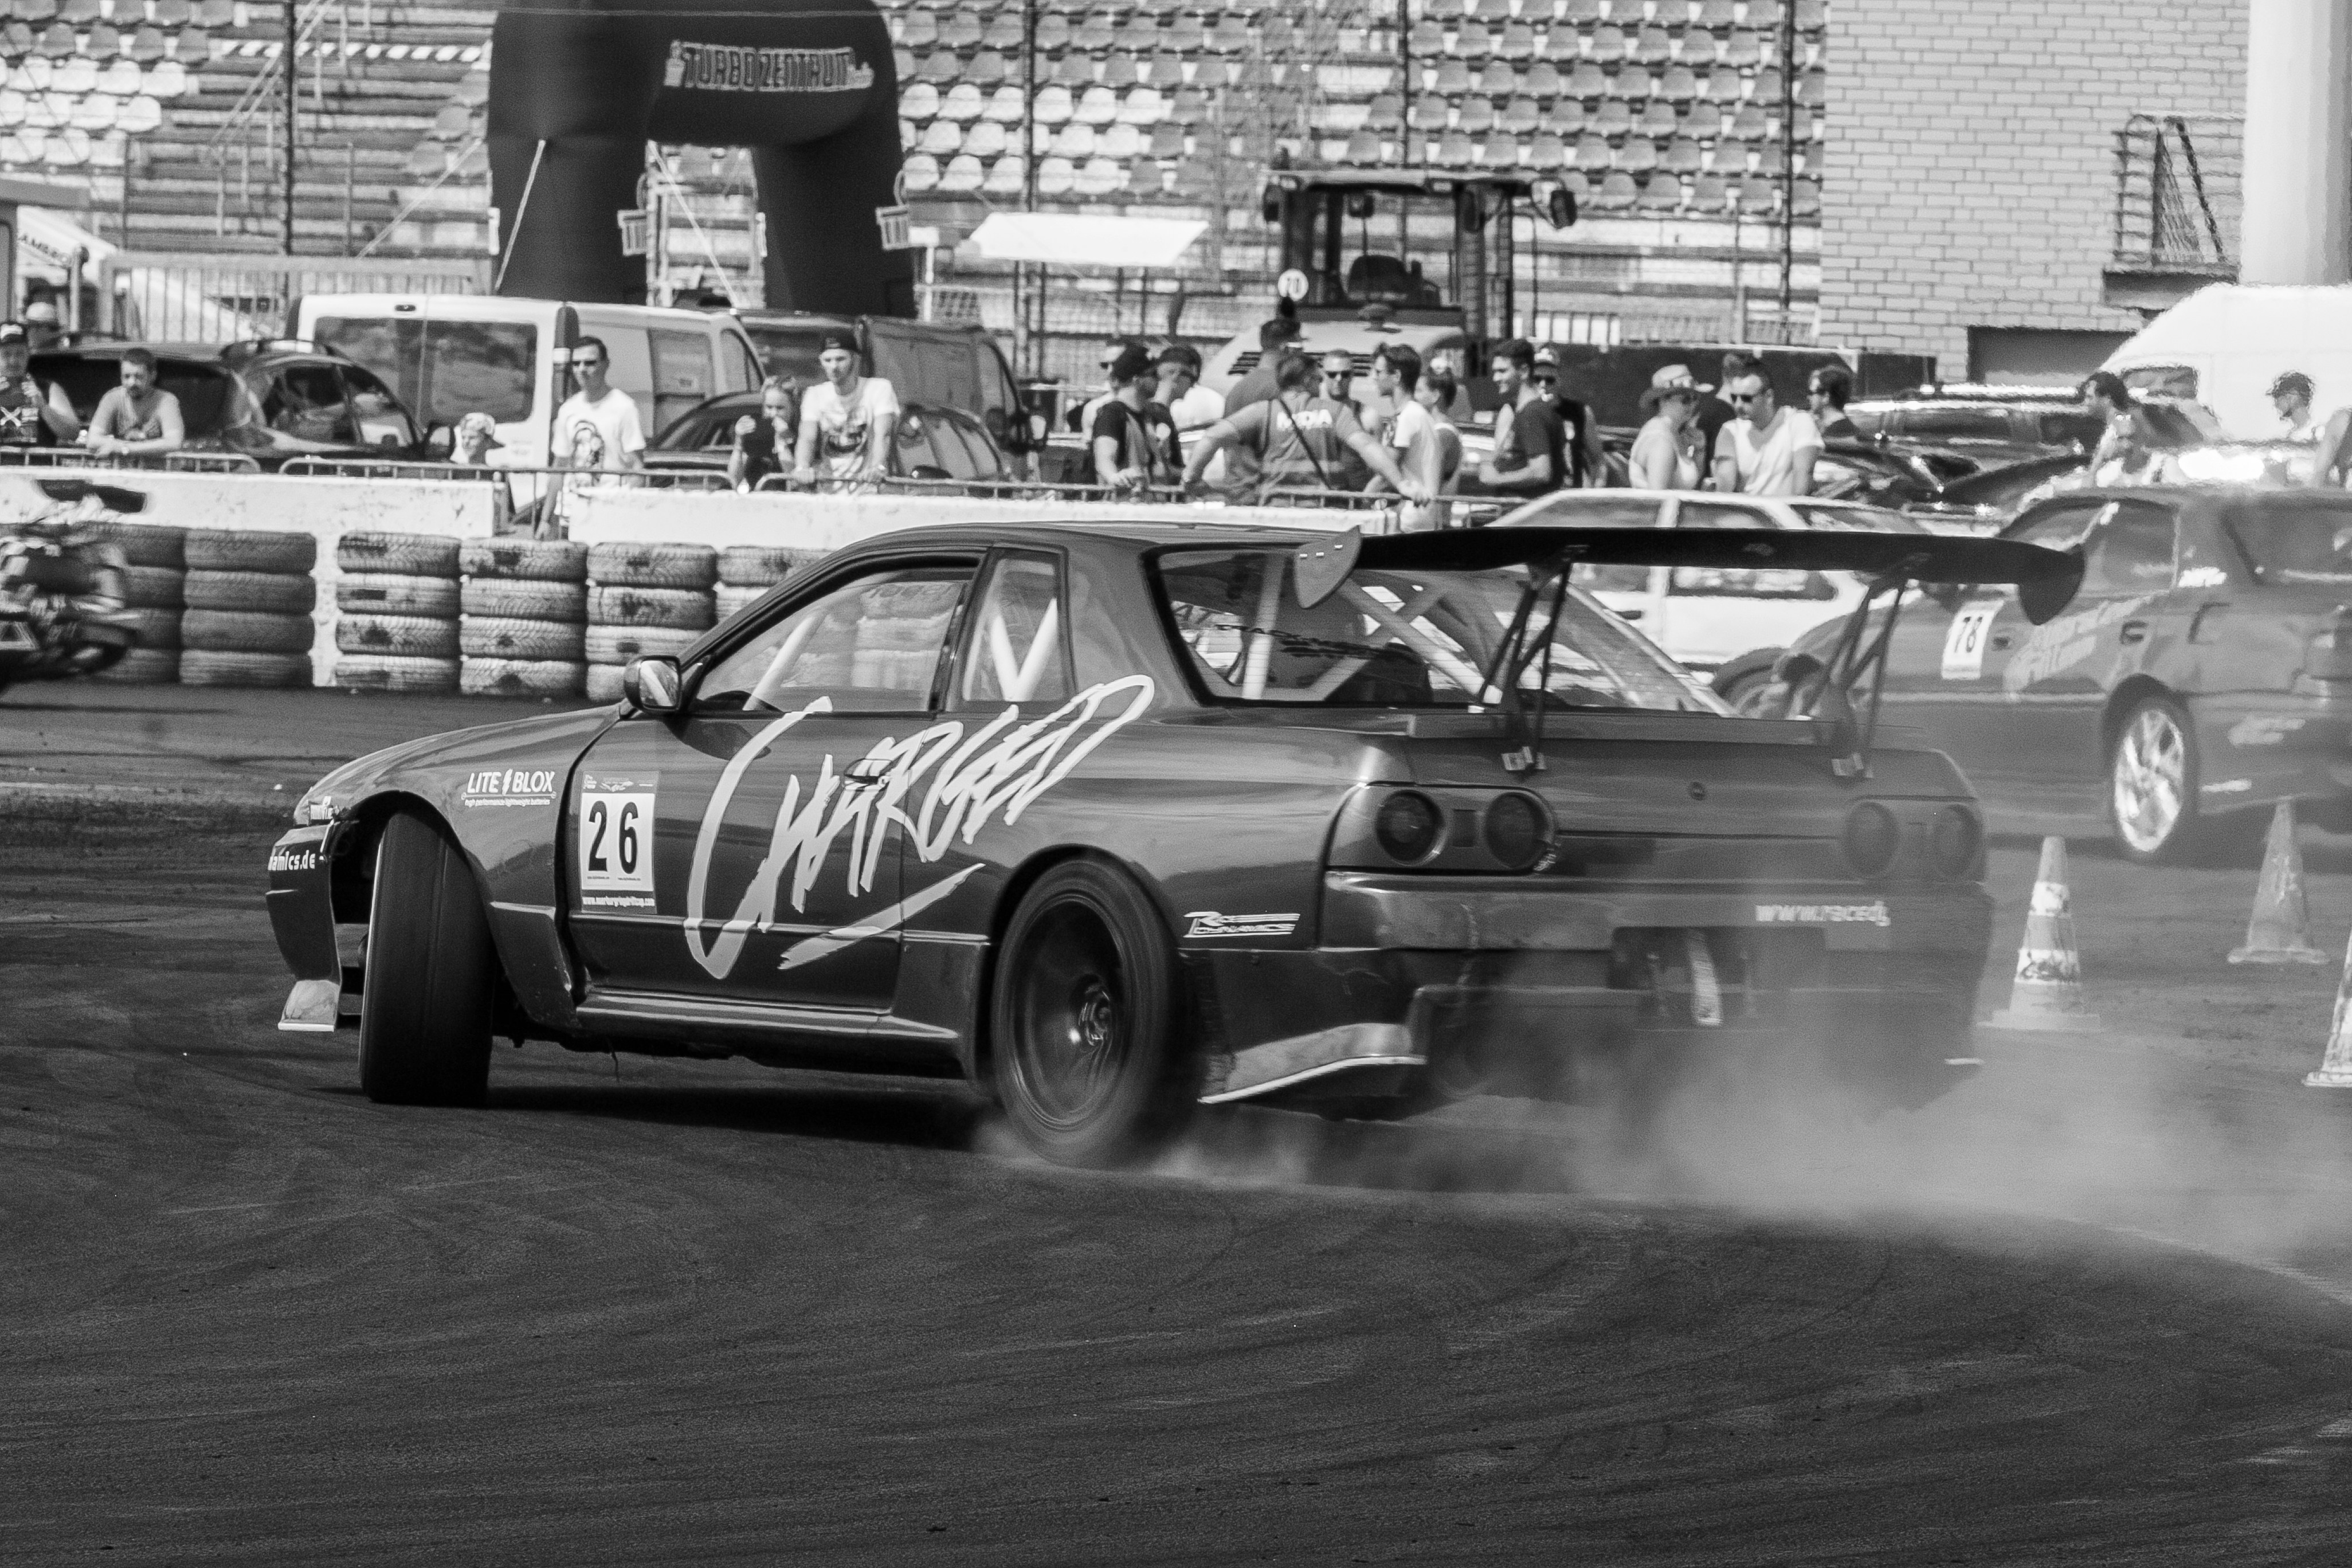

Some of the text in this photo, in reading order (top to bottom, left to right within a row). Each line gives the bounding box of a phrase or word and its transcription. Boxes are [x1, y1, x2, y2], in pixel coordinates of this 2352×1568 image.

[1953, 616, 1984, 653] 78
[467, 771, 555, 793] LITE BLOX
[588, 801, 638, 875] 26
